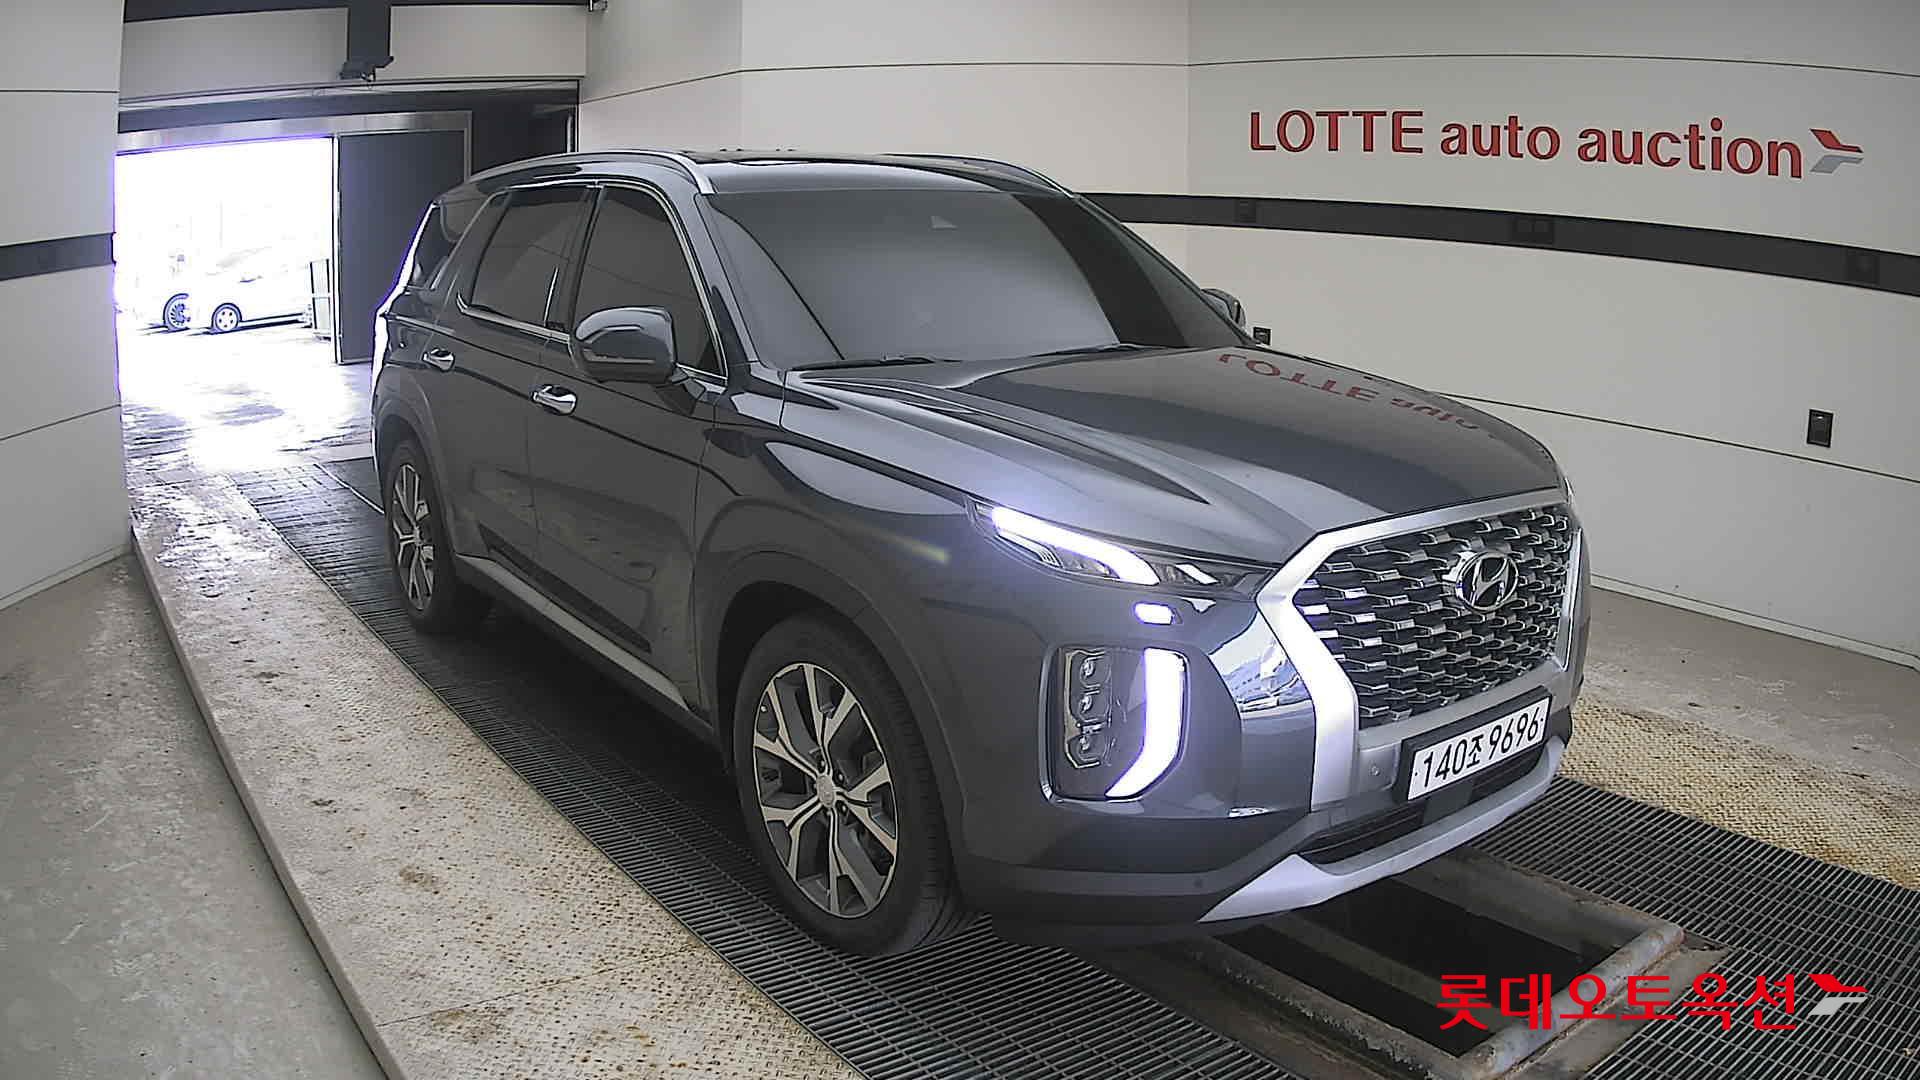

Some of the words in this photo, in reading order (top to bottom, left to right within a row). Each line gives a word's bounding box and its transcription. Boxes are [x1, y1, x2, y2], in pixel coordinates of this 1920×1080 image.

[1248, 110, 1424, 155] LOTTE
[1440, 114, 1563, 159] auto
[1576, 117, 1805, 179] auction
